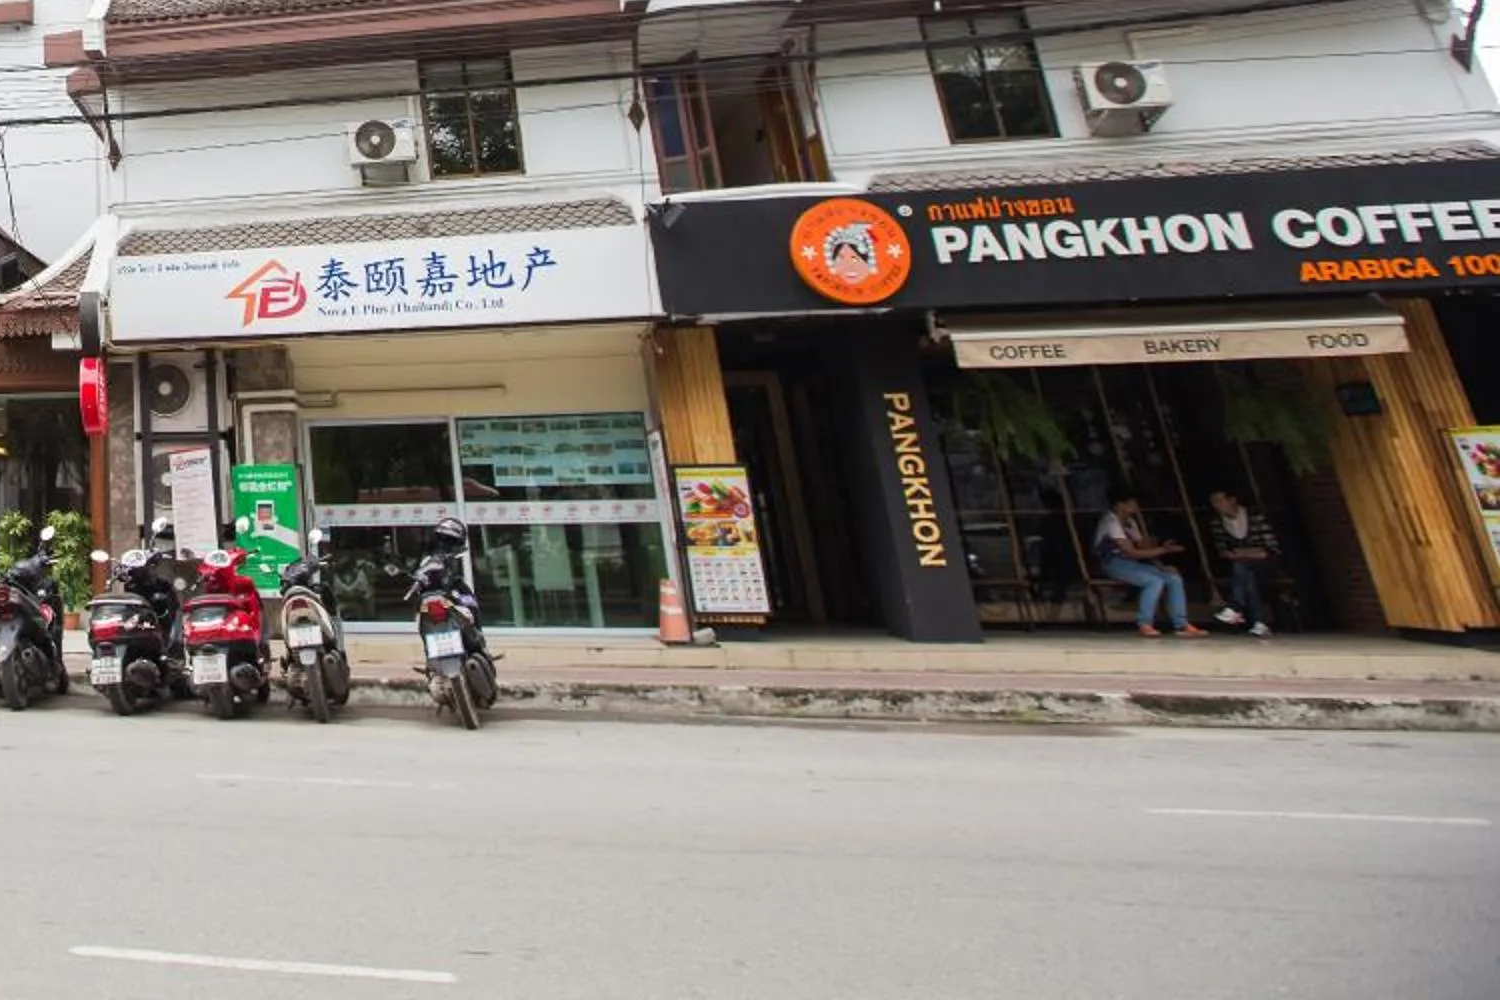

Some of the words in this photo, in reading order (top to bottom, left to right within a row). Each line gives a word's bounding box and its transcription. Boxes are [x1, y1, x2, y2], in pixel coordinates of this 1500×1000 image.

[931, 211, 1253, 264] PANGKHON
[1272, 198, 1500, 249] COFFEE
[316, 246, 557, 301] 泰颐嘉地产
[1300, 256, 1440, 282] ARABICA
[989, 344, 1067, 360] COFFEE
[1143, 337, 1221, 355] BAKERY
[1307, 333, 1369, 349] FOOD
[883, 391, 948, 567] PANGKHON
